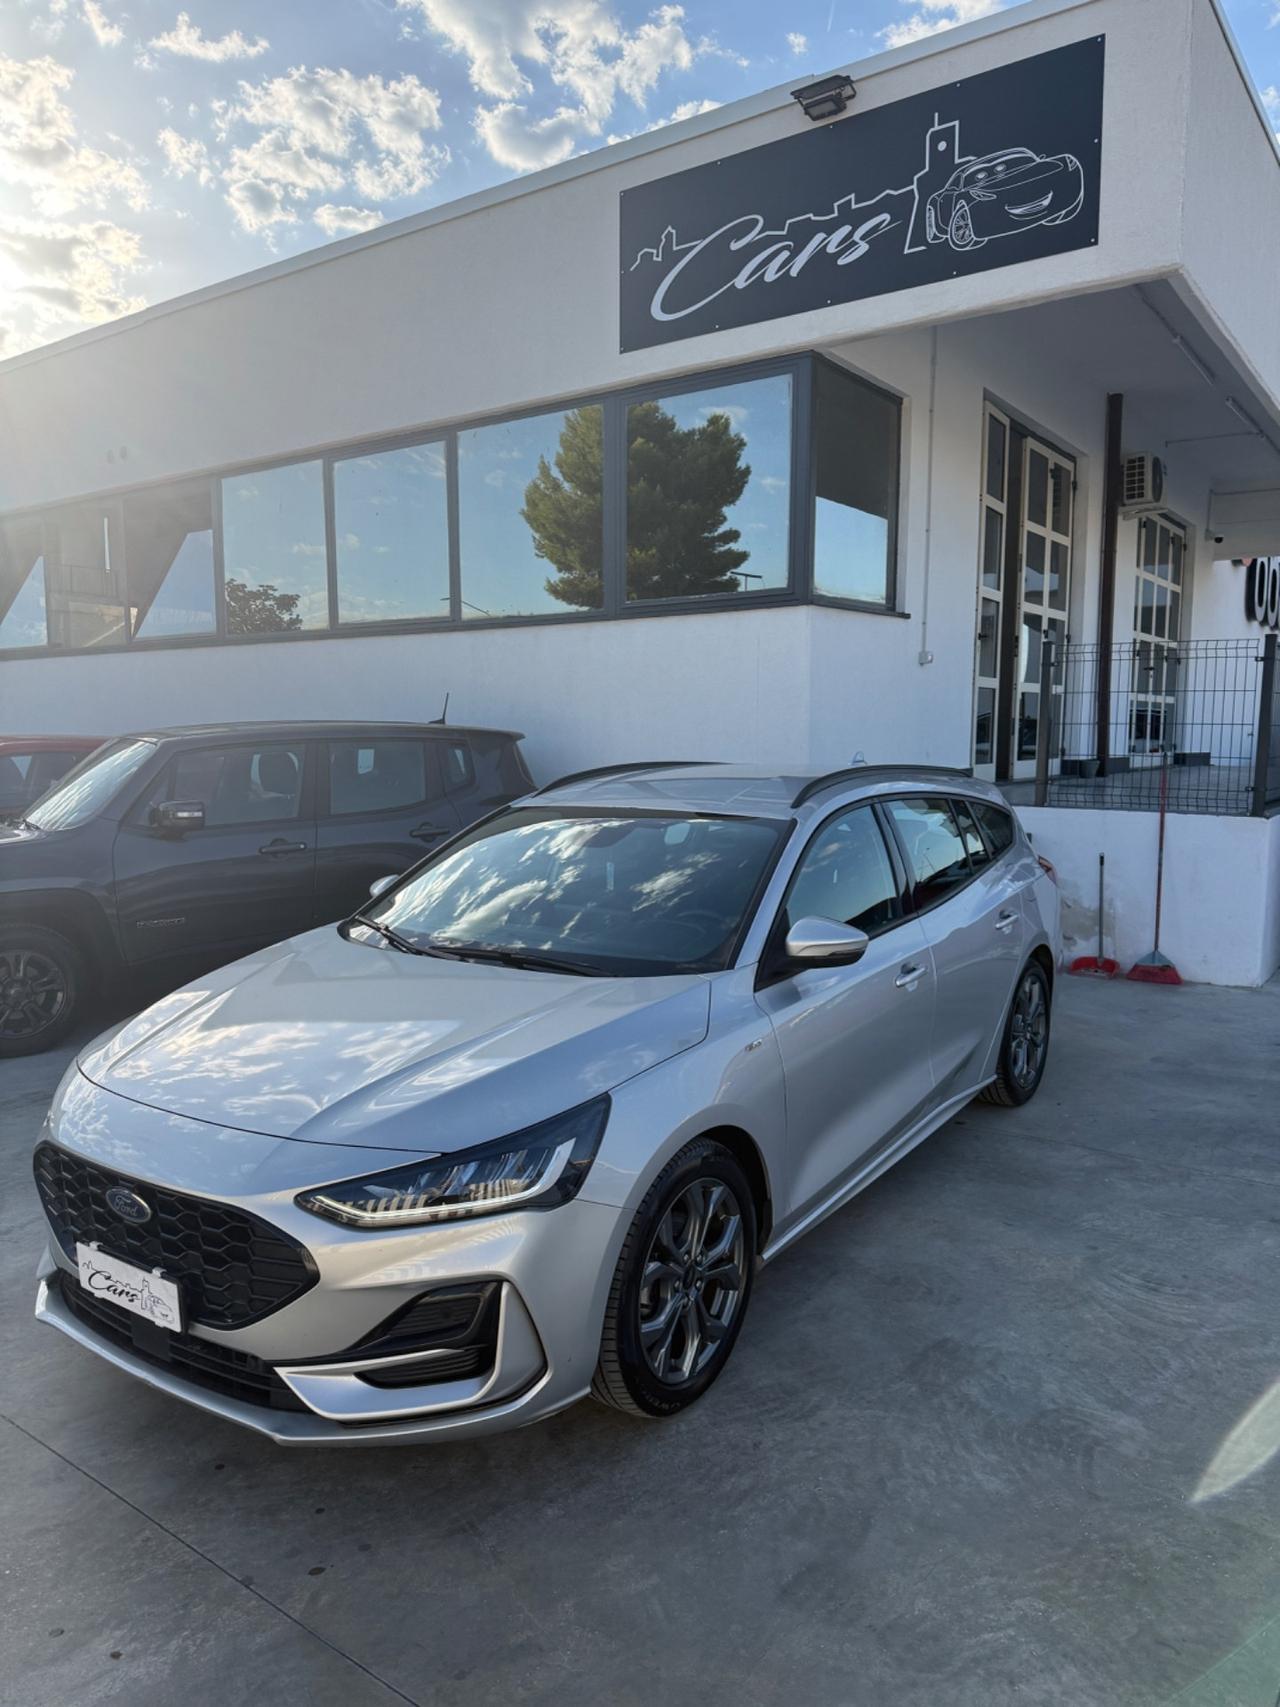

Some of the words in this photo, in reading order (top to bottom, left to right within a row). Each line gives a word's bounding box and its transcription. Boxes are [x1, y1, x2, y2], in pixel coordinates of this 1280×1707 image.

[650, 213, 902, 322] Cars
[113, 1195, 138, 1217] Ford
[88, 1270, 139, 1303] Cars
